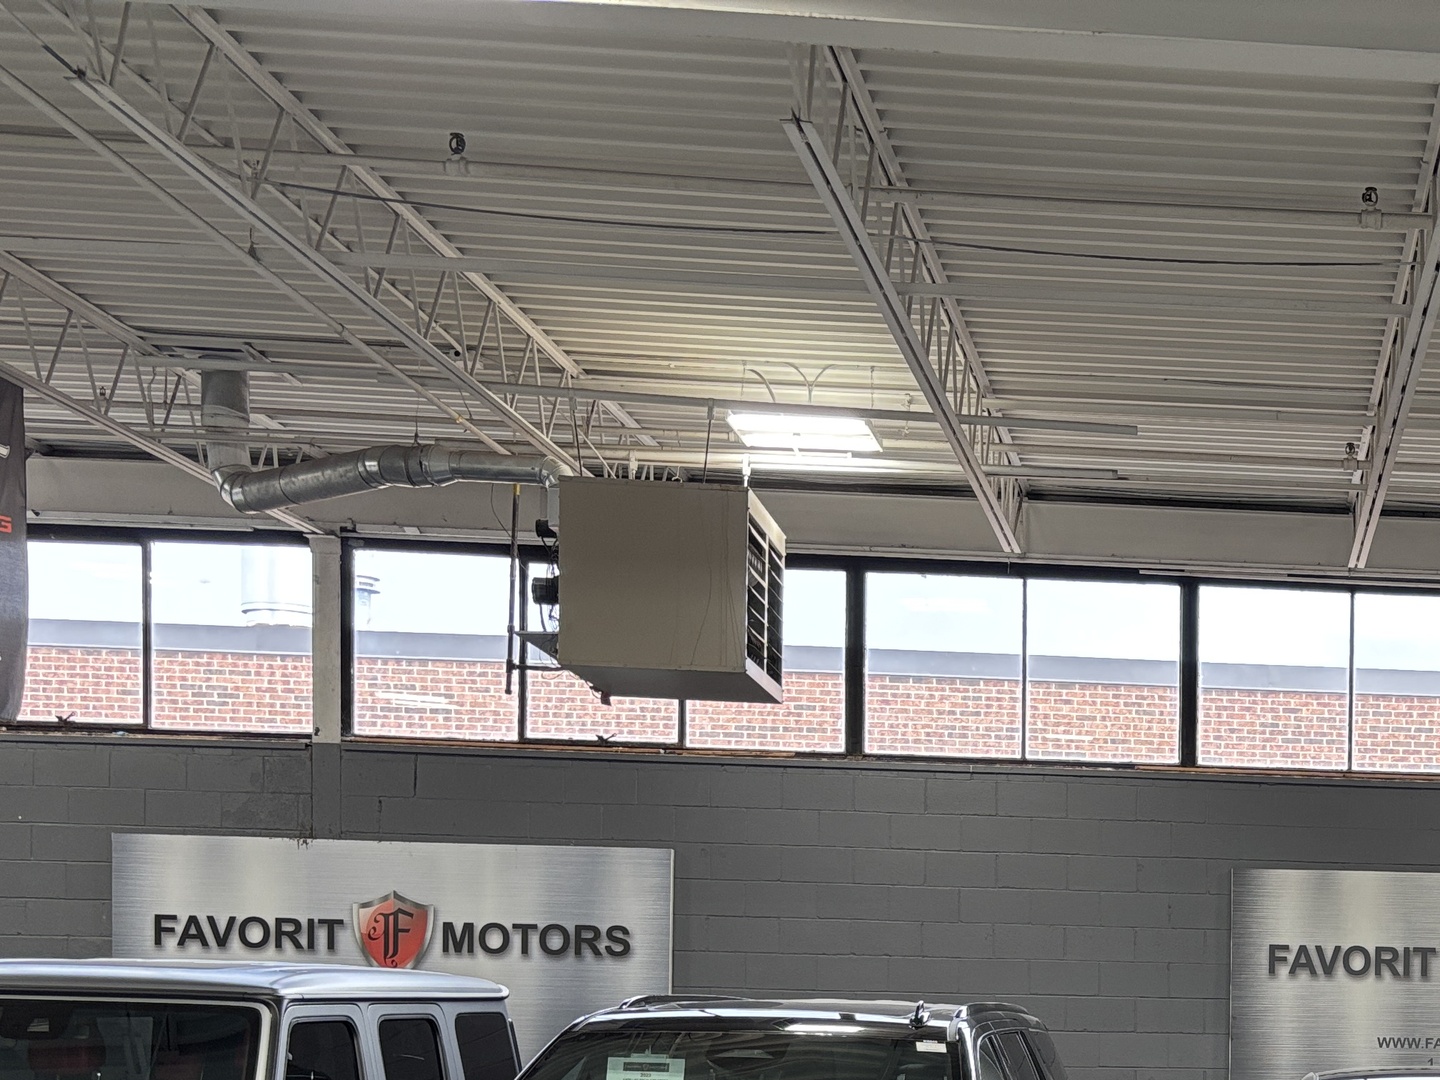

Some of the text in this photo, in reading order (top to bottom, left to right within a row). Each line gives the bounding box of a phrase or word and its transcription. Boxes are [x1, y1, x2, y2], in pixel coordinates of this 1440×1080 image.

[153, 913, 632, 958] FAVORIT MOTORS
[1267, 943, 1437, 979] FAVORIT
